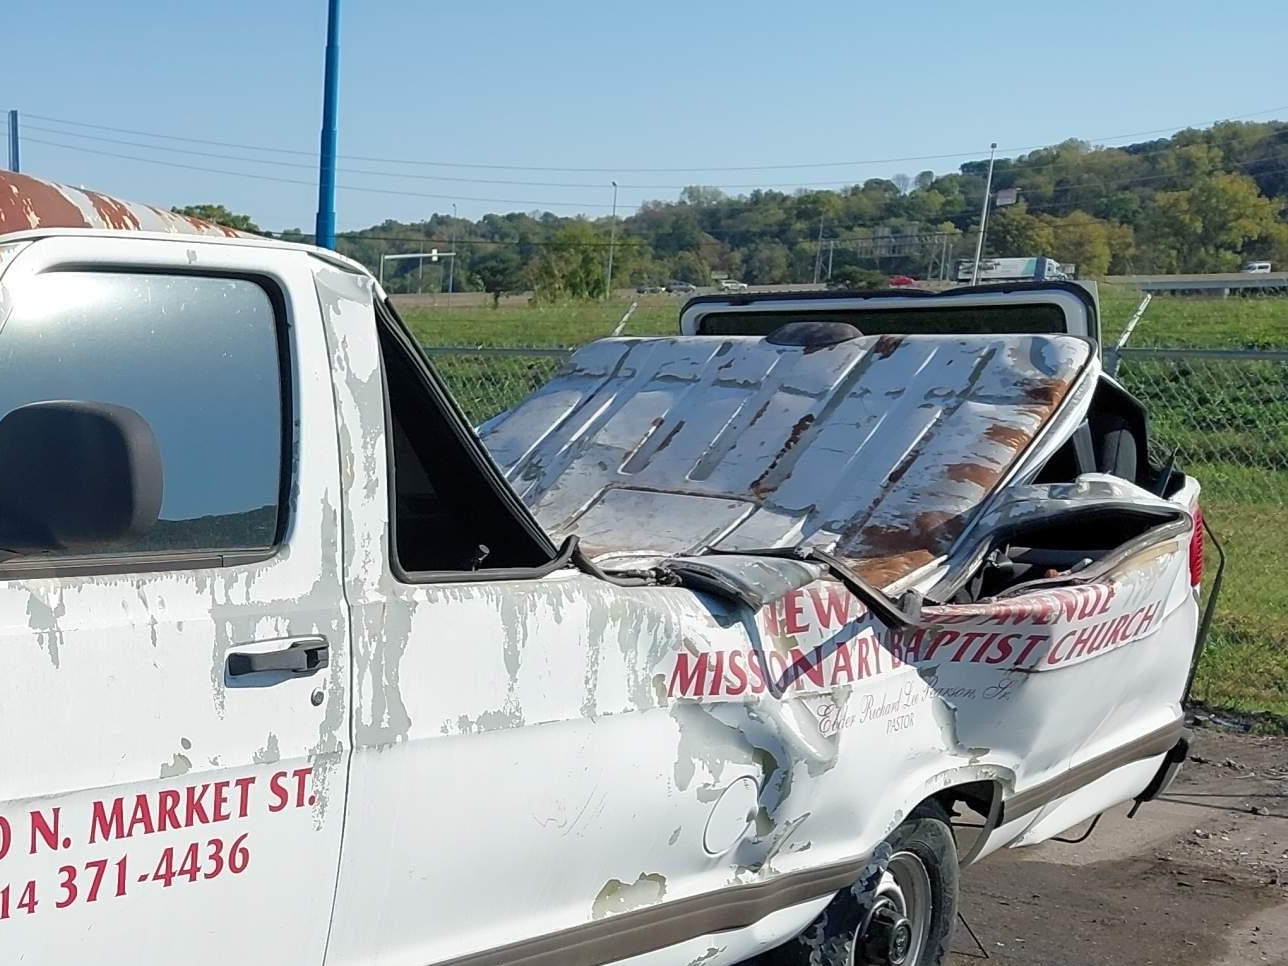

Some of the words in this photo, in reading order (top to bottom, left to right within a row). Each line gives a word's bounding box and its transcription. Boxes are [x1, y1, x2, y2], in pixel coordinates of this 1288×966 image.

[890, 628, 1050, 669] BAPTIST
[1047, 602, 1161, 665] CHURCH
[859, 687, 903, 723] Richard
[886, 712, 915, 735] PASTOR
[28, 807, 71, 854] N.
[89, 776, 257, 844] MARKET
[268, 767, 316, 813] ST.
[55, 833, 250, 908] 371-4436
